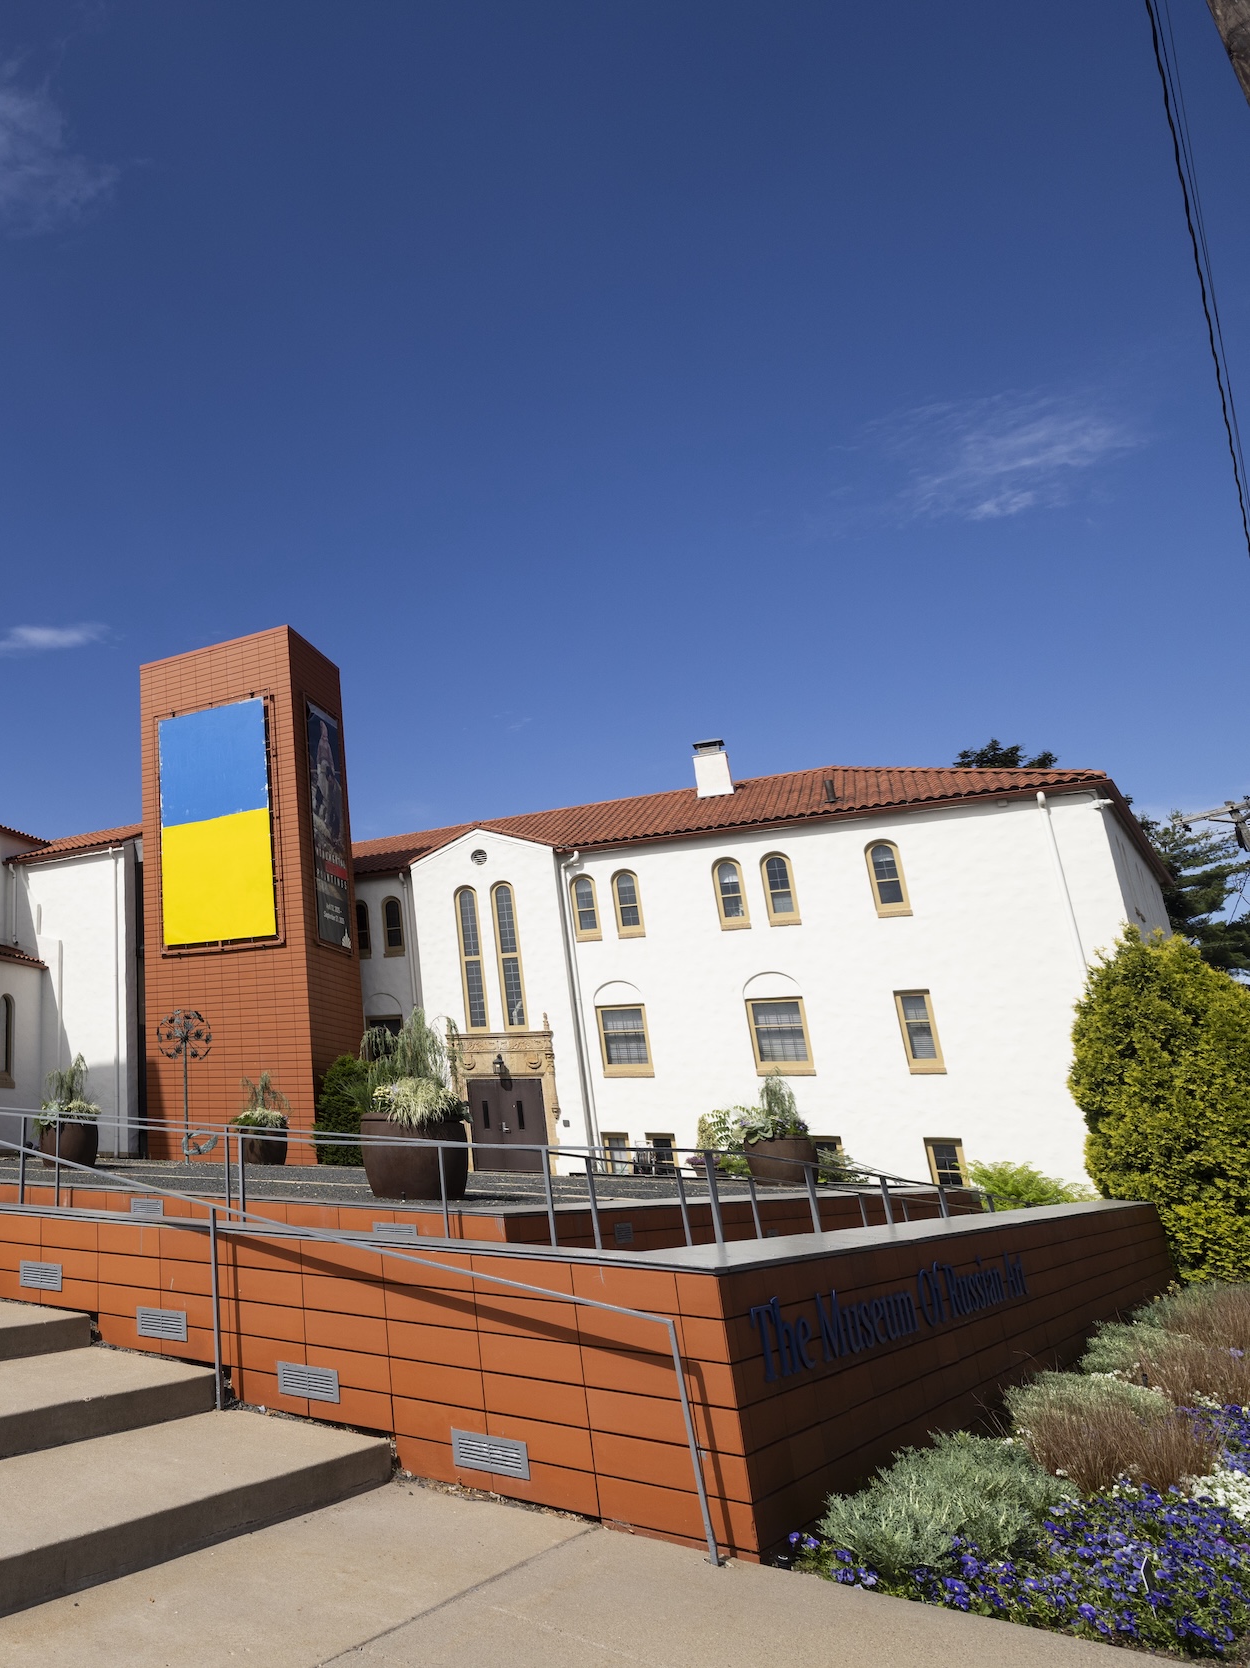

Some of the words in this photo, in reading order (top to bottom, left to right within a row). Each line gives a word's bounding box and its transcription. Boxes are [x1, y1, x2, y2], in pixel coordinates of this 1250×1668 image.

[750, 1296, 816, 1382] The
[815, 1289, 920, 1363] Museum
[917, 1260, 947, 1328] Of
[943, 1255, 1005, 1319] Russian
[1003, 1250, 1030, 1298] Art
